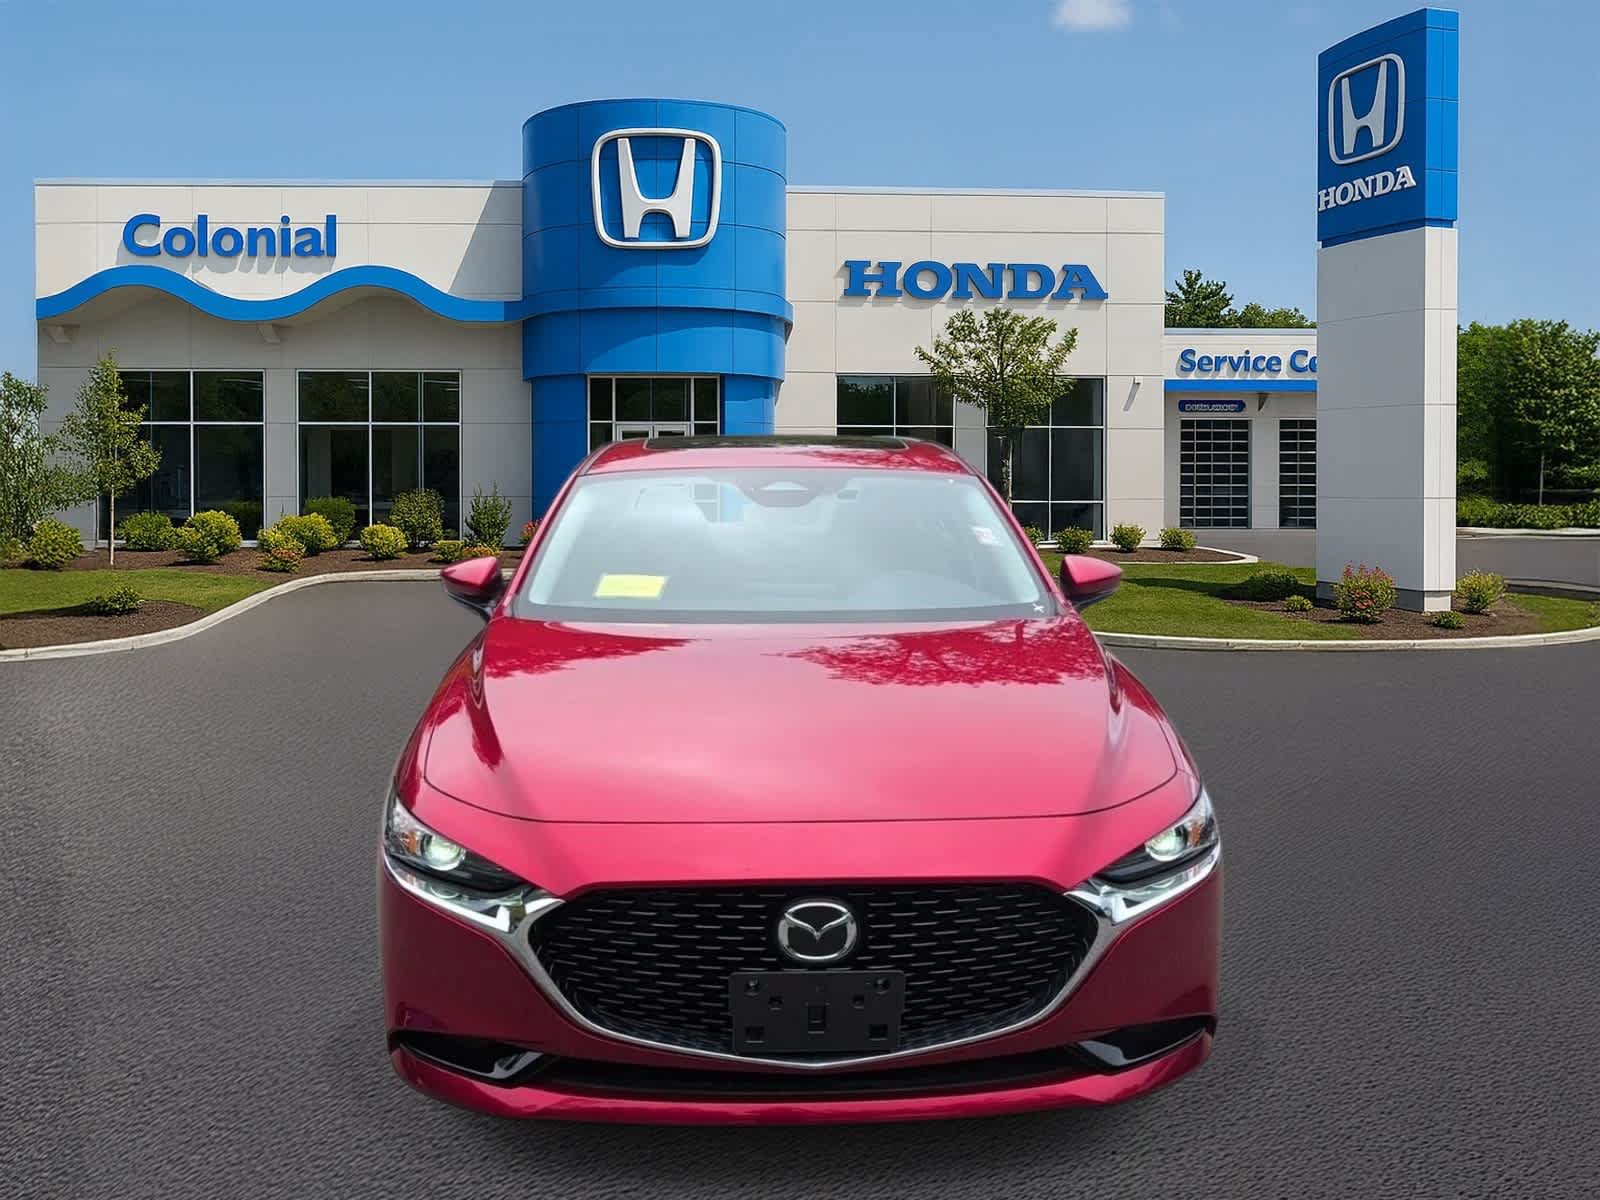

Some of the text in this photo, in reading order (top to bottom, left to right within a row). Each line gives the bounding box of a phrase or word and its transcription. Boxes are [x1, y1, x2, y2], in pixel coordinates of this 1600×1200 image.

[1318, 166, 1416, 212] HONDA
[122, 213, 337, 257] Colonial
[843, 260, 1109, 299] HONDA
[1180, 348, 1282, 373] Service
